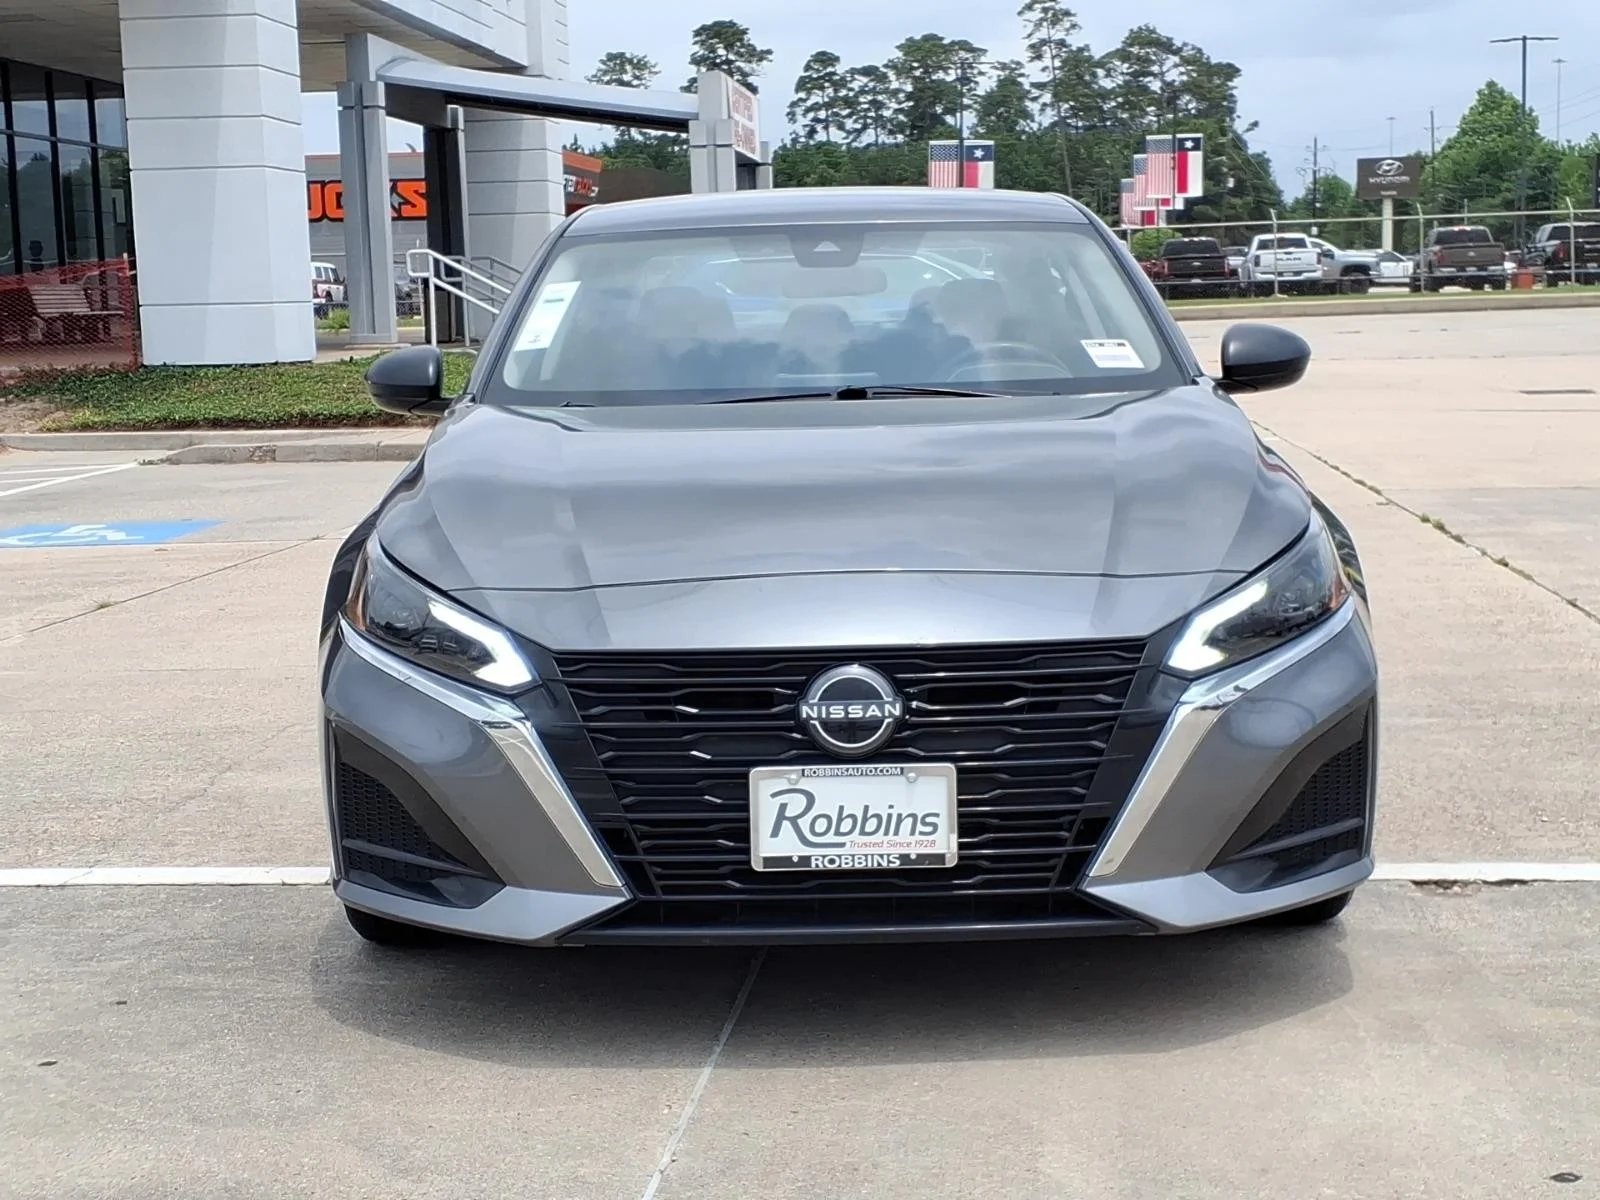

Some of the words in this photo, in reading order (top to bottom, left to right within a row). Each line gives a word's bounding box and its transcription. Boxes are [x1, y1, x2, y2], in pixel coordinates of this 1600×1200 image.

[802, 703, 900, 718] NISSAN
[804, 767, 902, 777] ROBBINSAUTO.COM
[769, 788, 940, 848] Robbins
[849, 840, 884, 848] Trusted
[887, 840, 912, 848] Since
[915, 840, 936, 848] 1928
[811, 855, 901, 868] ROBBINS
